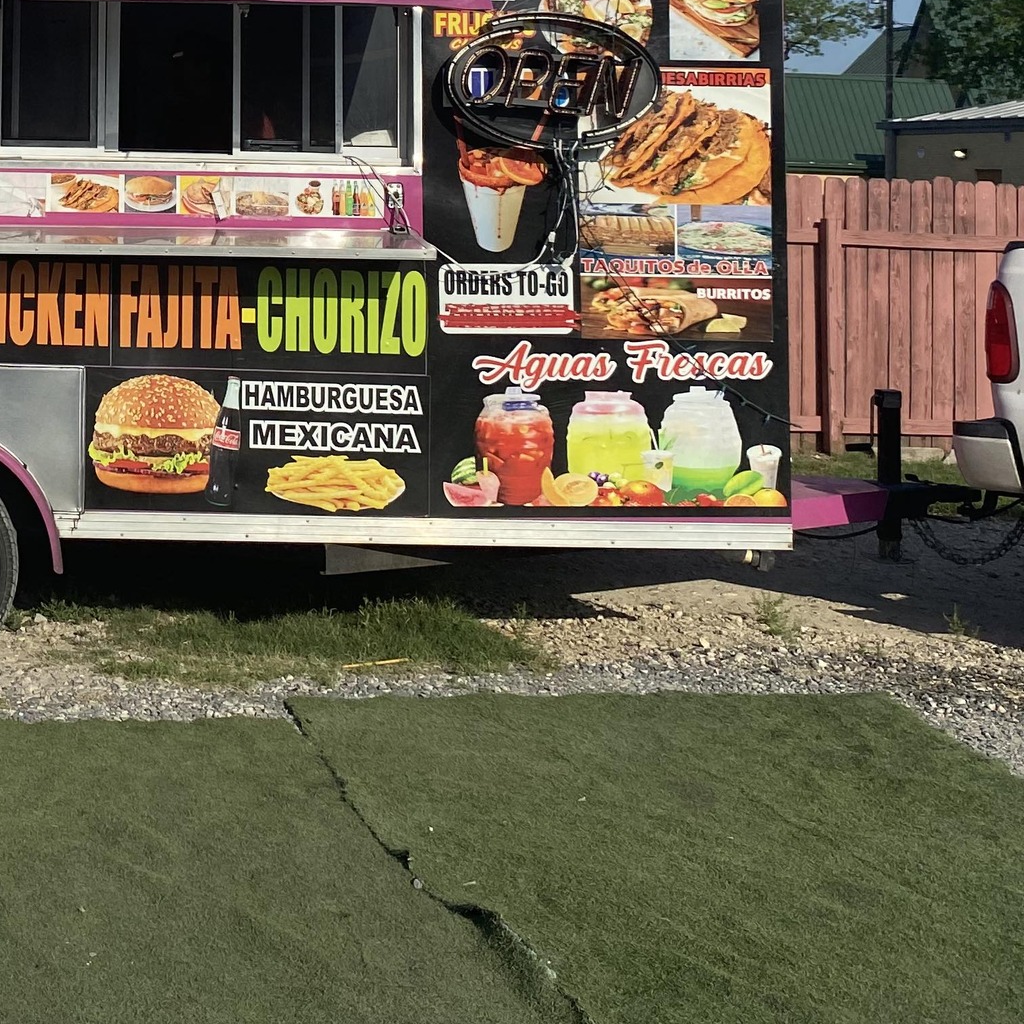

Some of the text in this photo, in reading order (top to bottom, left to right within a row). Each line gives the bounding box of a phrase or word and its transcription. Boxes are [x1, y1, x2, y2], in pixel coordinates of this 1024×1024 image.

[461, 44, 644, 119] OPEN
[661, 71, 766, 87] ESABIRRIAS
[581, 258, 769, 275] TAQUITOS de OLLA
[444, 269, 569, 297] ORDERS TO-GO
[696, 287, 772, 301] BURRITOS
[473, 340, 773, 391] Aguas Frescas
[243, 381, 423, 415] HAMBURGUESA
[249, 421, 422, 454] MEXICANA
